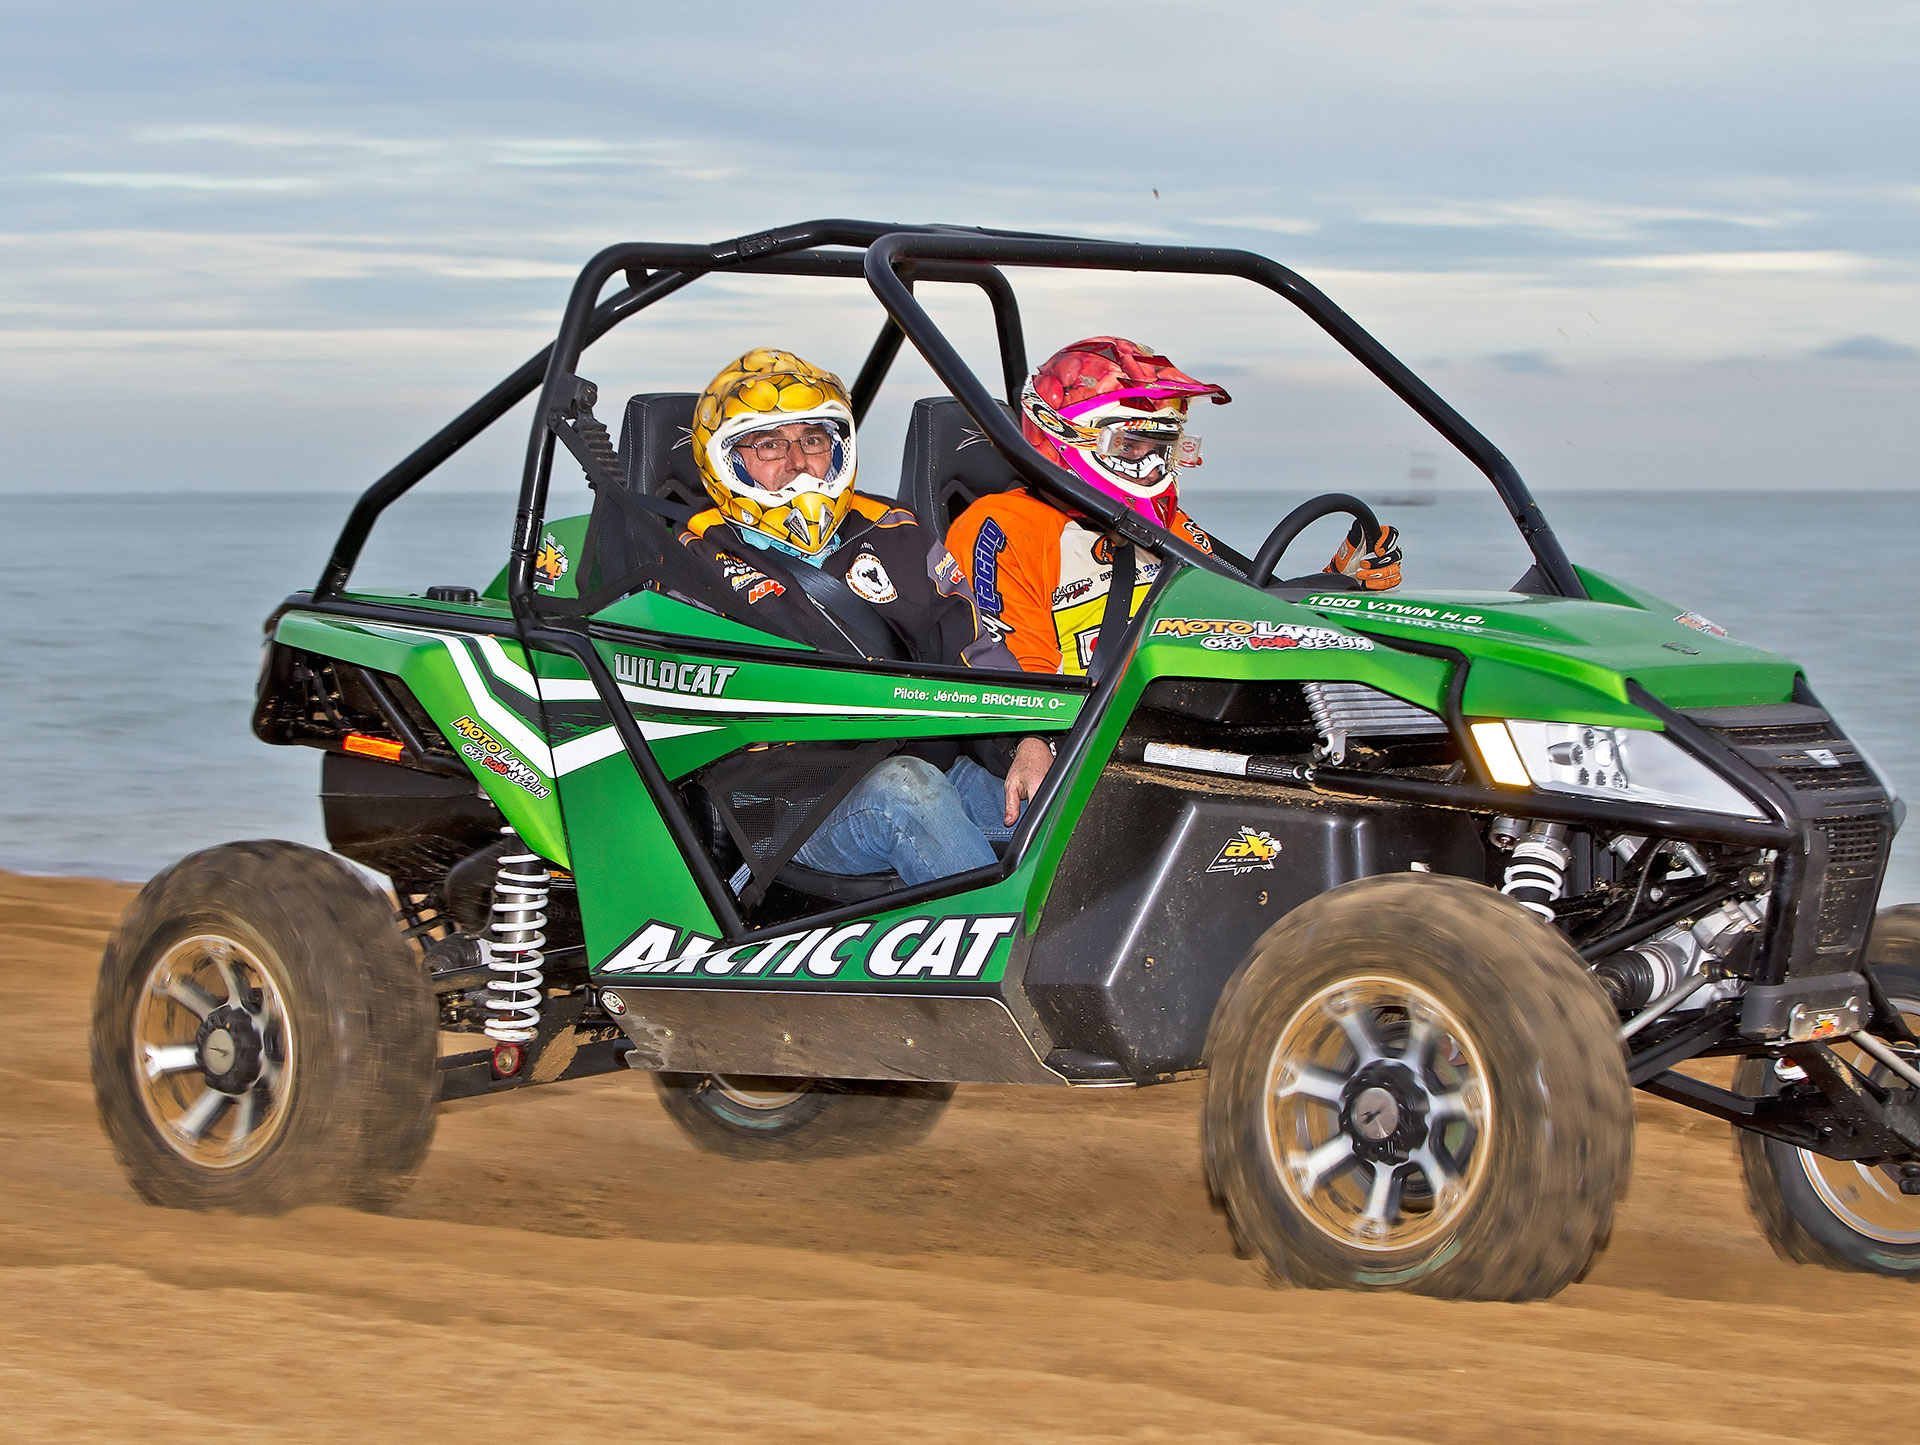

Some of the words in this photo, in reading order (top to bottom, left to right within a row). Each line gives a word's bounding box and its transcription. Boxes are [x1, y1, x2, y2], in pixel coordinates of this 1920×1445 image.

[1308, 596, 1361, 608] 1000
[1367, 601, 1439, 618] V-TWIN
[1440, 612, 1486, 625] H.O.
[1153, 619, 1255, 637] MOTO
[1255, 621, 1345, 640] LAND
[1201, 636, 1245, 650] OFF
[1249, 637, 1299, 650] ROAD
[614, 652, 740, 697] WILDCAT
[893, 687, 930, 701] Pilote:
[933, 689, 978, 704] Jérôme
[981, 692, 1045, 709] BRICHEUX
[451, 715, 503, 754] MOTO
[494, 748, 540, 786] LAND
[462, 743, 485, 761] OFF
[481, 755, 509, 776] ROAD
[864, 914, 1020, 980] CAT
